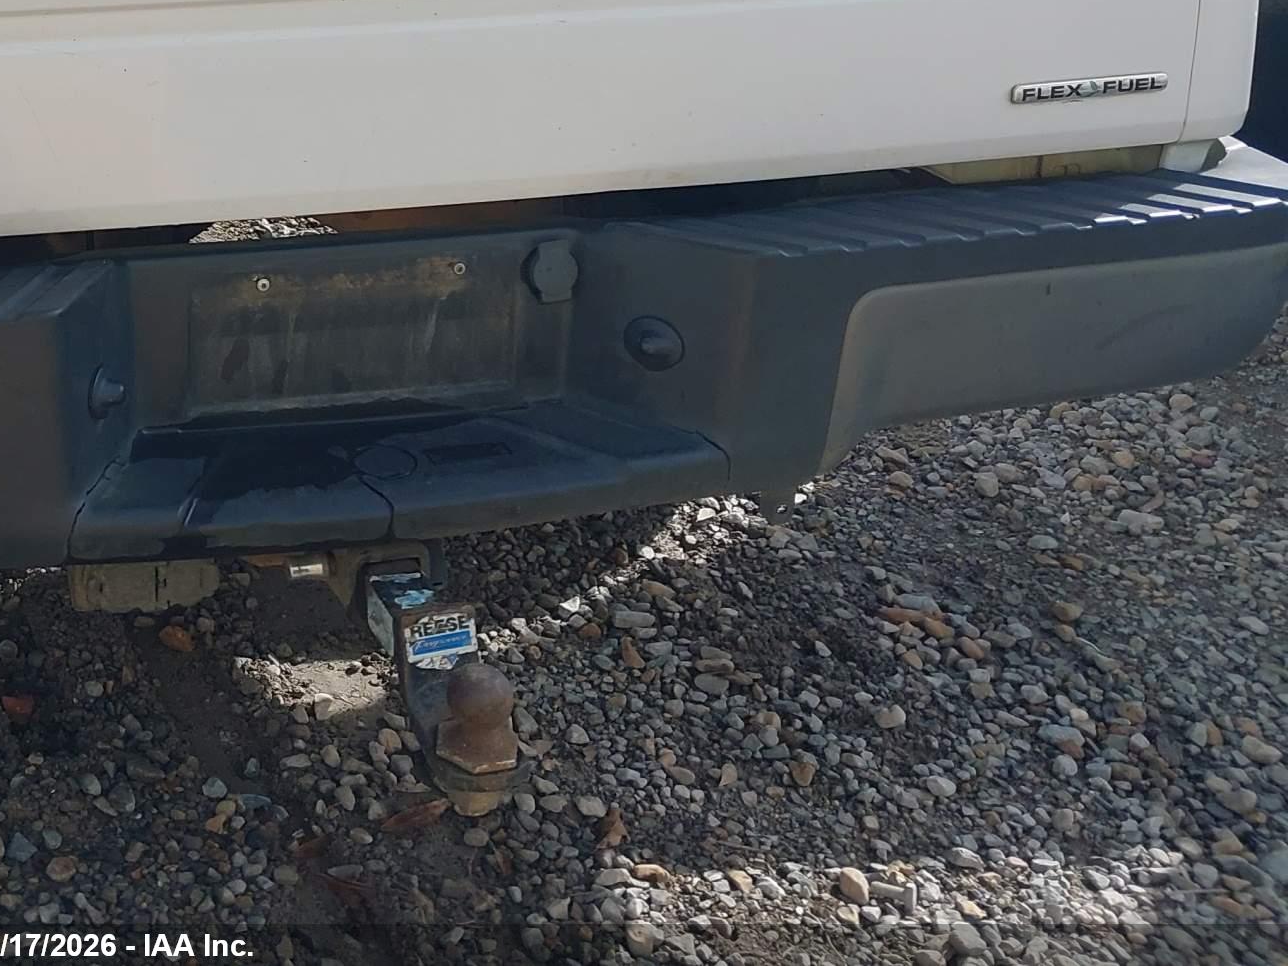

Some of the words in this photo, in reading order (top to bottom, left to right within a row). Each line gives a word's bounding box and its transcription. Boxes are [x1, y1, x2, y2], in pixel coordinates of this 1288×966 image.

[1021, 83, 1083, 102] FLEX
[1102, 77, 1163, 94] FUEL
[410, 615, 471, 639] REESE
